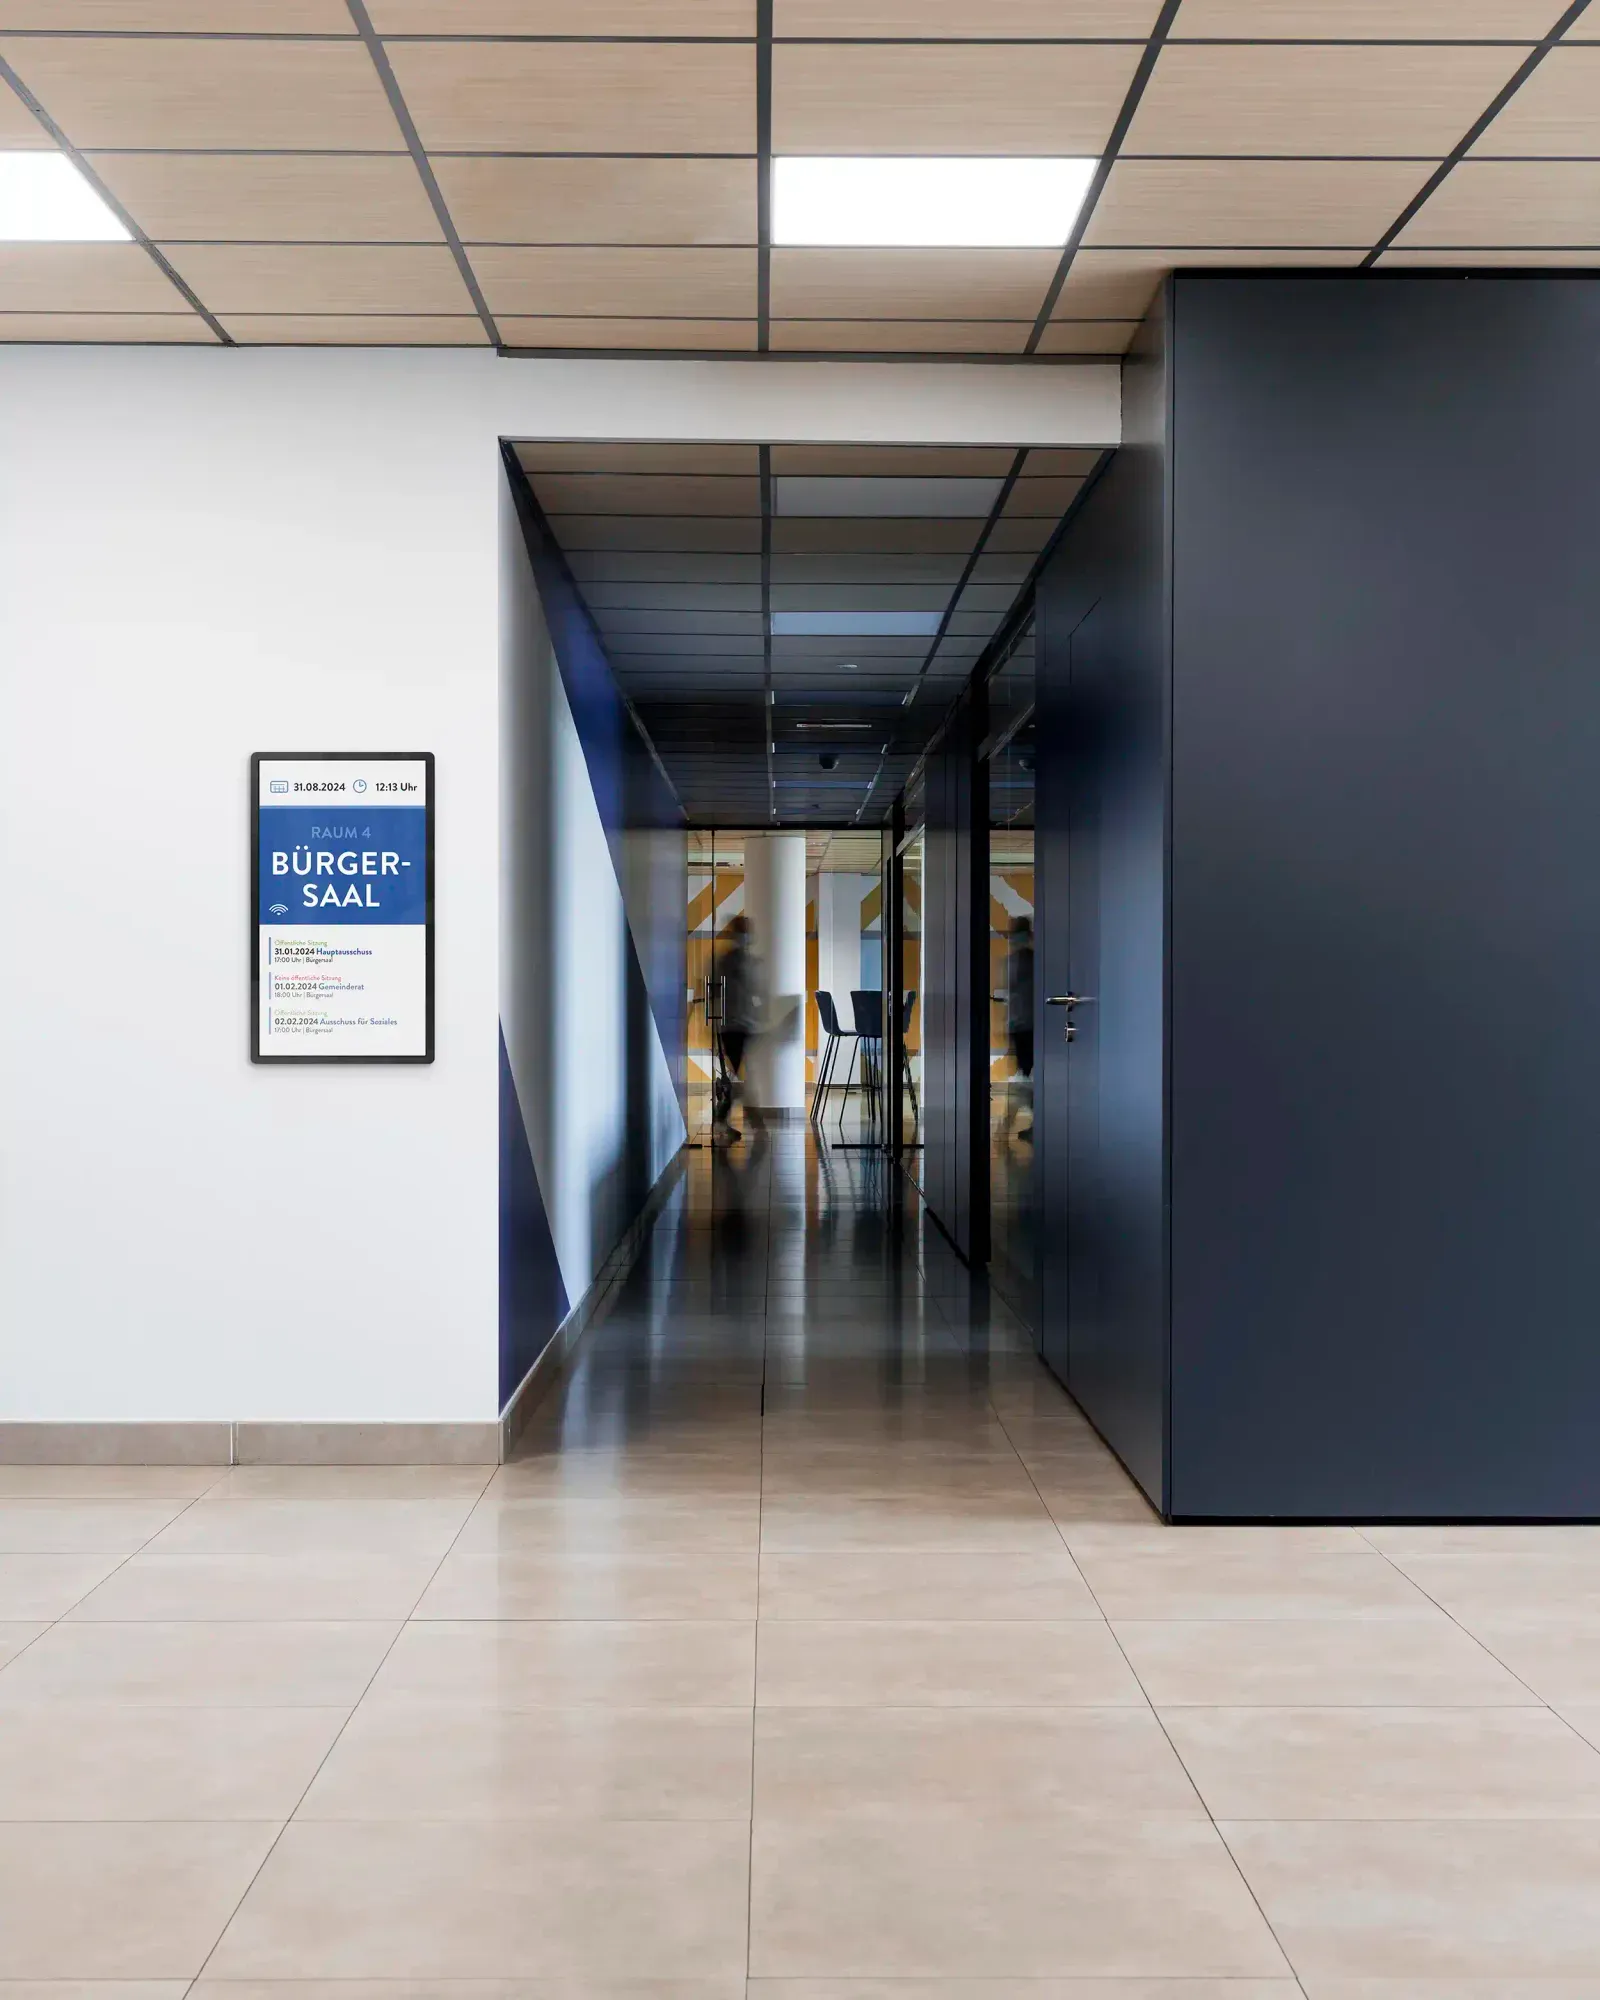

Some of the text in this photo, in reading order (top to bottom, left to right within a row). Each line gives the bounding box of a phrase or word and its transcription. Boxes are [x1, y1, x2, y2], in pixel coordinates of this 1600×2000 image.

[293, 782, 418, 792] 31.08.2024 12:13 Uhr
[311, 826, 371, 839] RAUM 4
[272, 845, 411, 875] BÜRGER-
[302, 883, 380, 907] SAAL
[316, 948, 373, 957] Hauptausschuss
[321, 974, 342, 983] Sitzung
